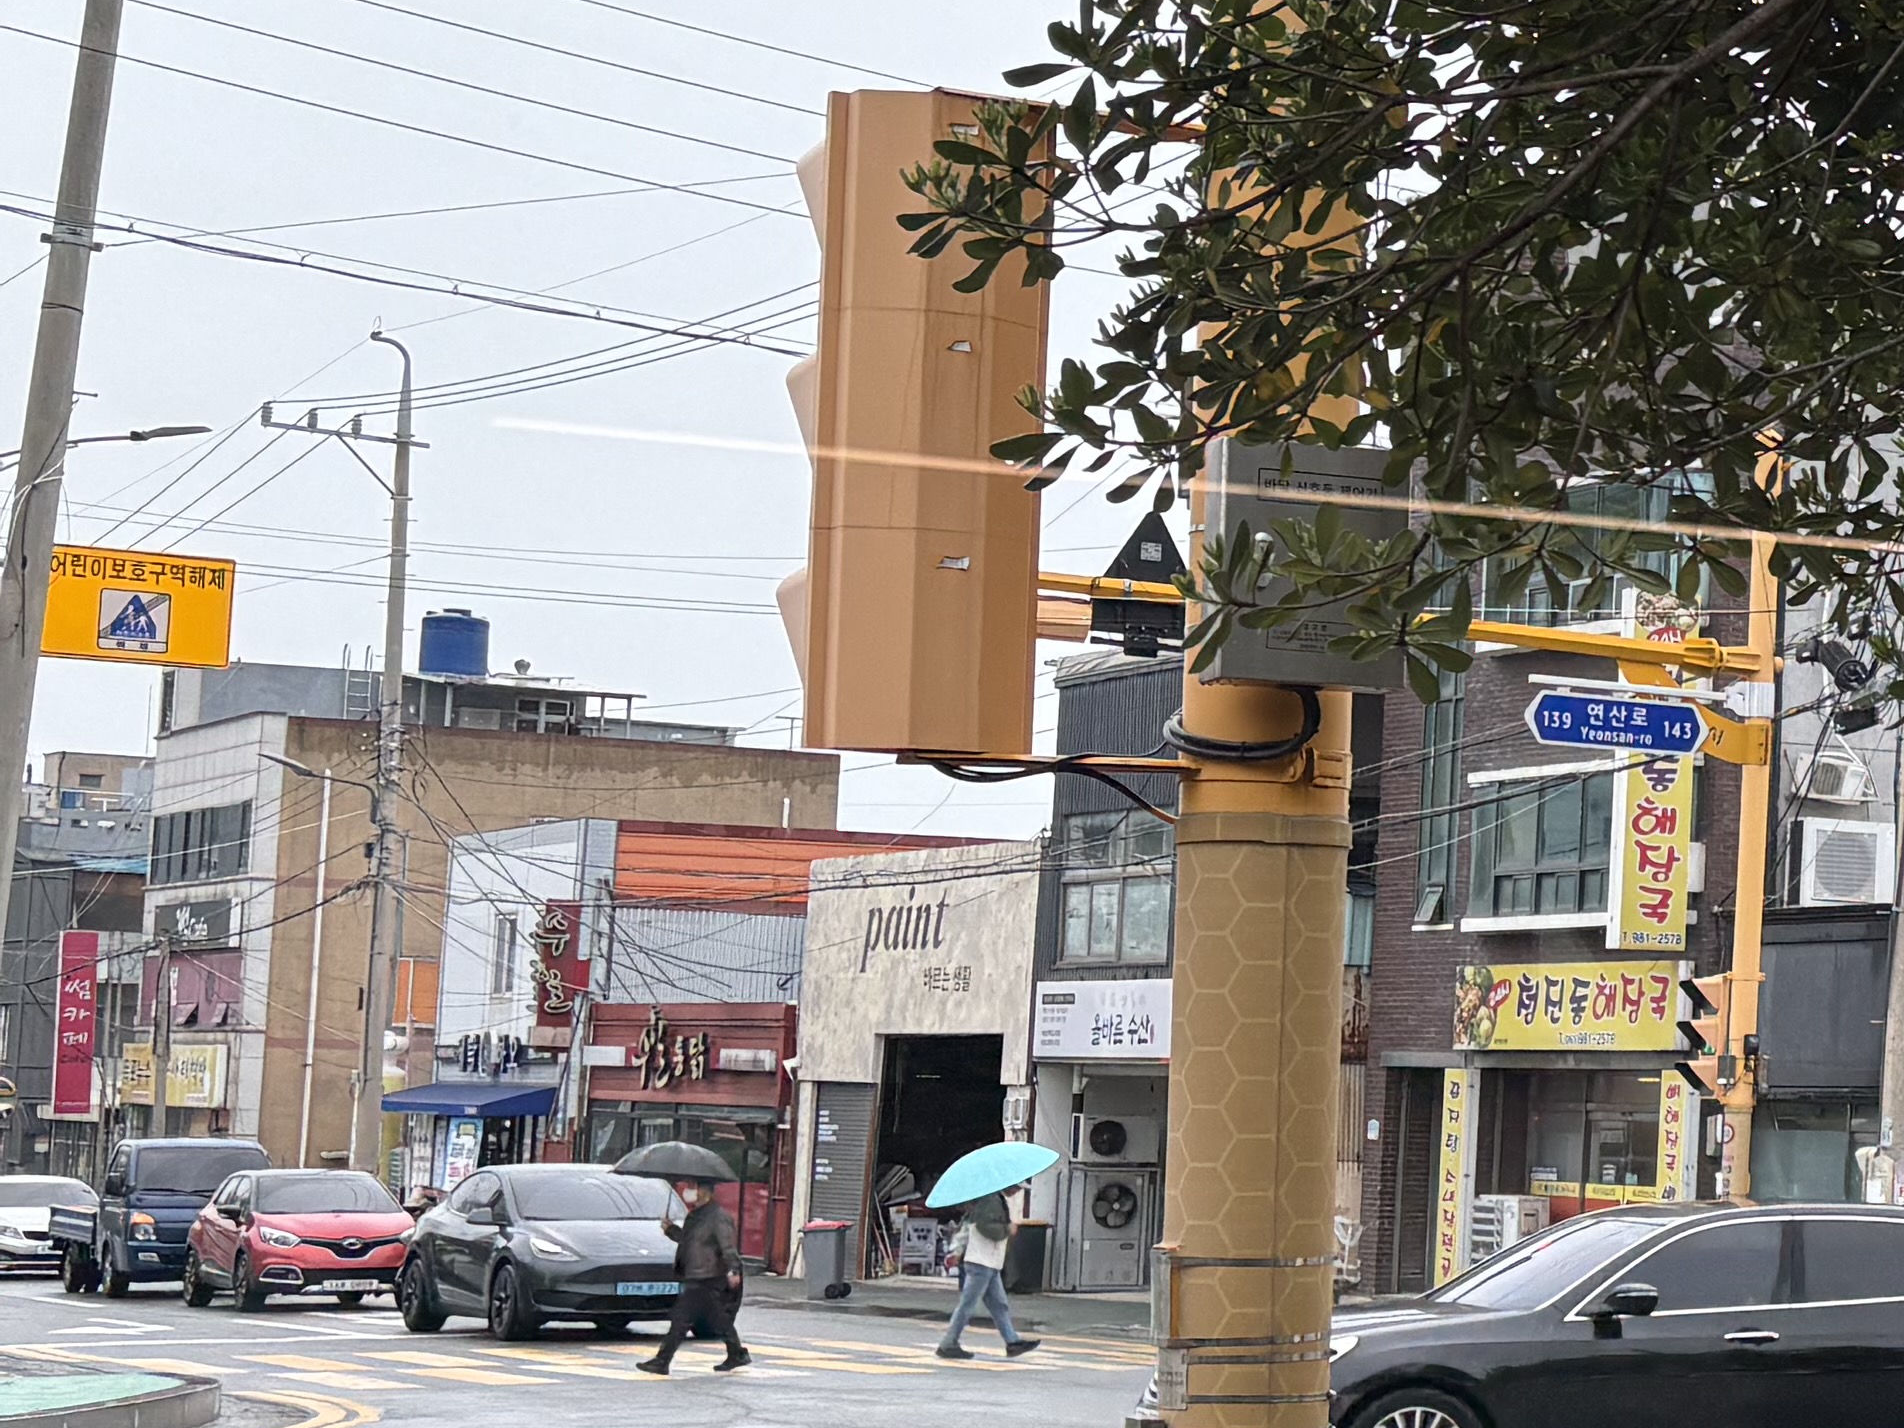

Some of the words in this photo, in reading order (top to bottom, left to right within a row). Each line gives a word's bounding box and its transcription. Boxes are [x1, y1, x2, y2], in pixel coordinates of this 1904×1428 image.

[50, 553, 226, 591] 어린이보호구역해제
[1542, 710, 1572, 729] 139
[1587, 703, 1648, 727] 연산로
[1663, 721, 1692, 740] 143
[1580, 725, 1653, 745] Yeonsan-ro
[860, 886, 950, 973] paint
